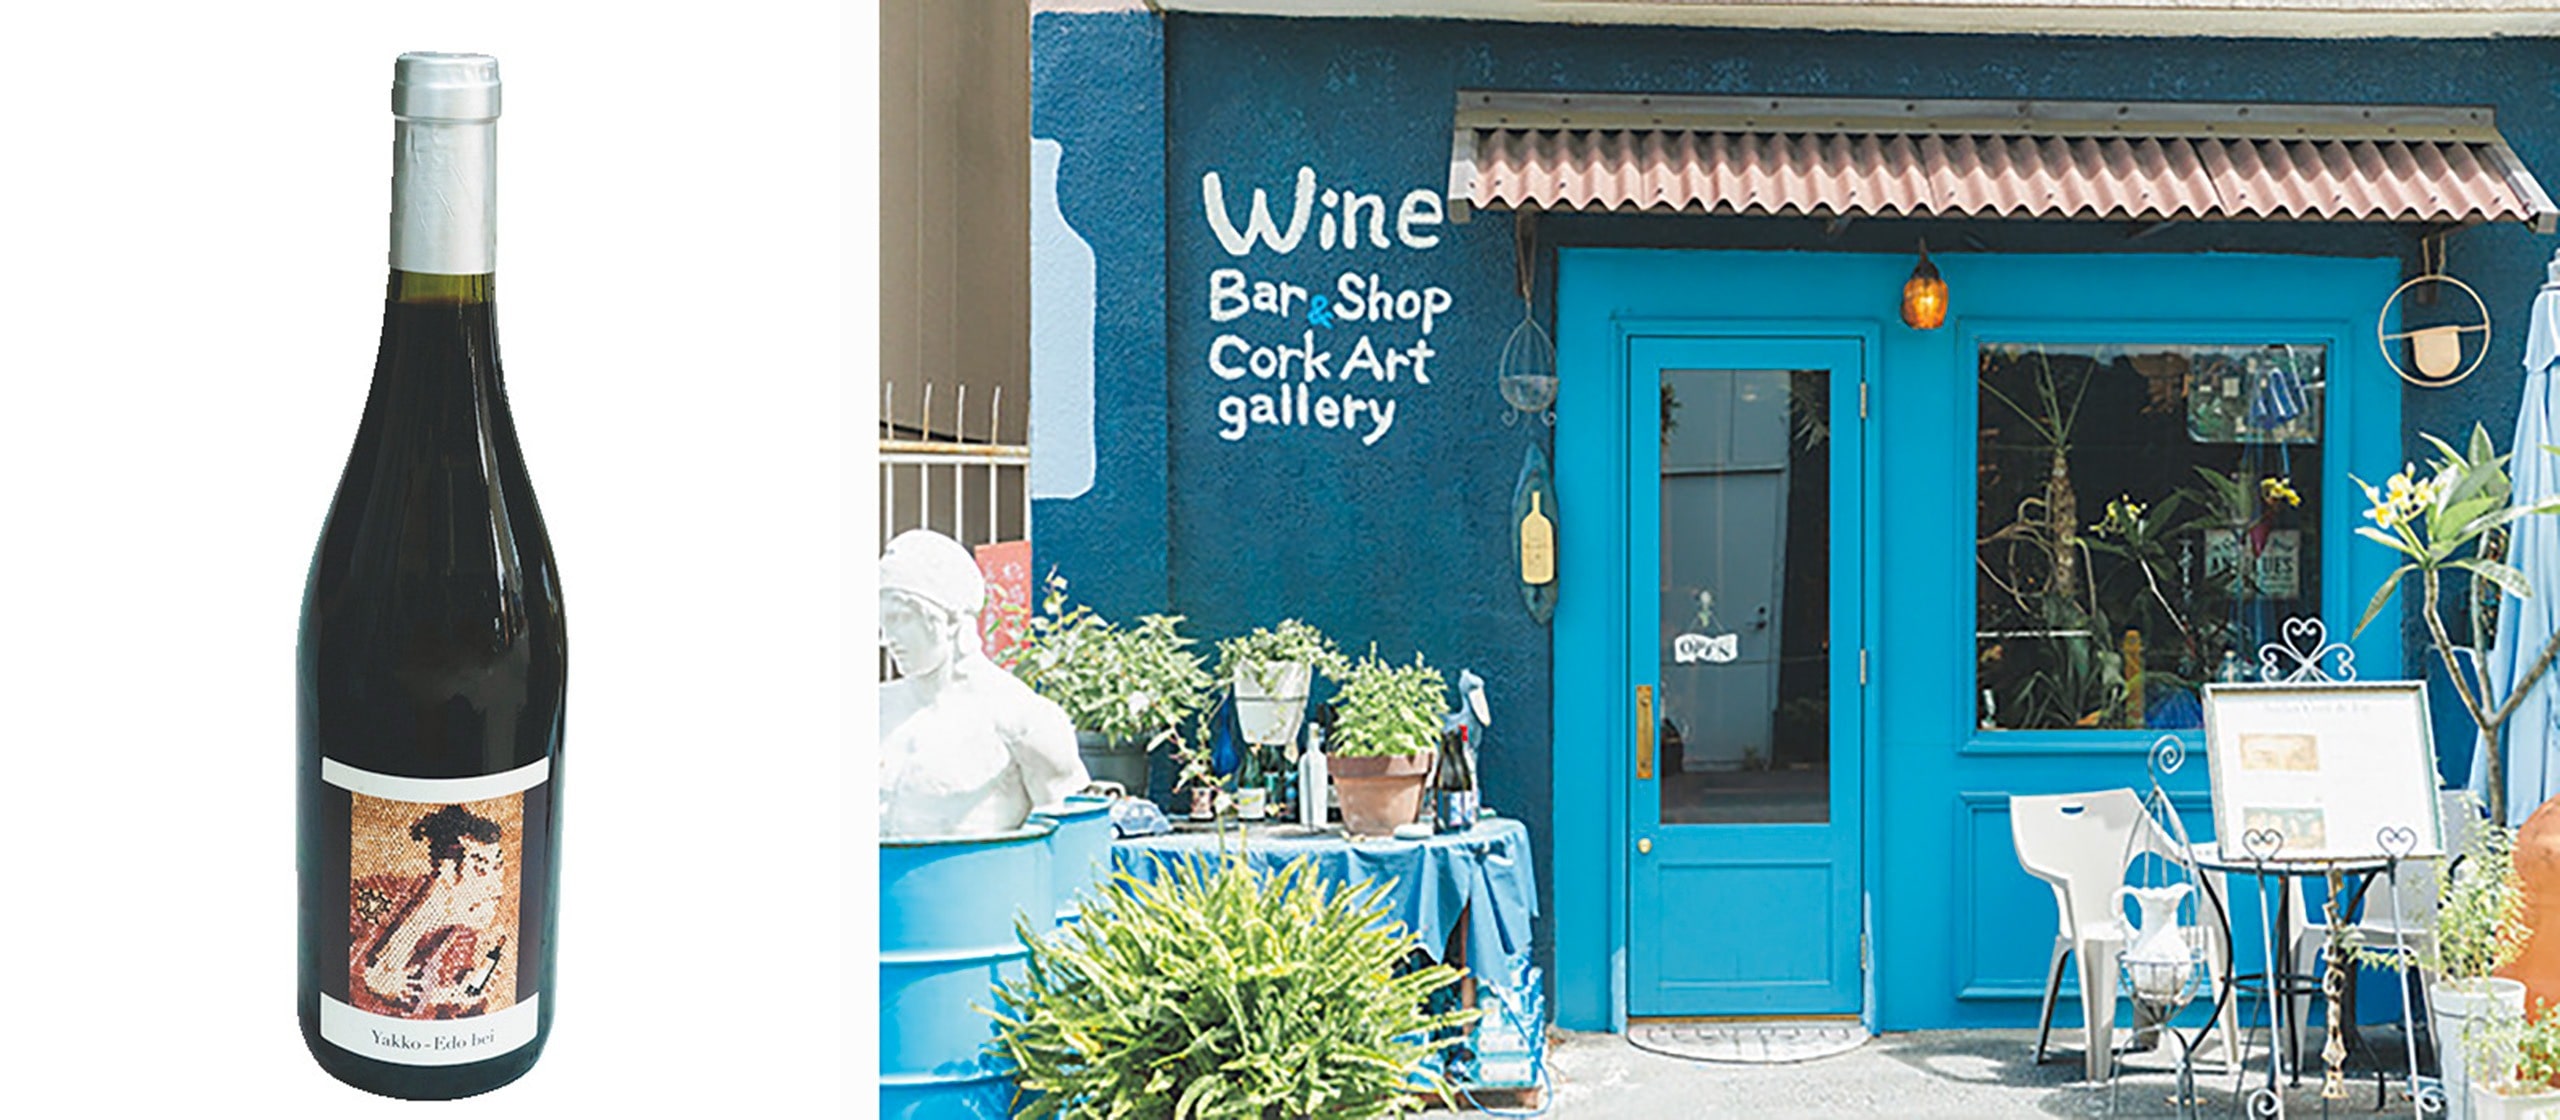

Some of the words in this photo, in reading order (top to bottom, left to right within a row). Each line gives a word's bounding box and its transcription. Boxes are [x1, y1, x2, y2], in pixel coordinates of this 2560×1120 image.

[1203, 166, 1443, 256] Wine
[1209, 268, 1307, 322] Bar
[1306, 294, 1334, 330] &
[1333, 272, 1452, 334] Shop
[1209, 329, 1331, 382] Cork
[1339, 335, 1436, 384] Art
[1218, 382, 1396, 446] gallery
[372, 1029, 421, 1050] Yakko
[434, 1035, 467, 1050] Edo
